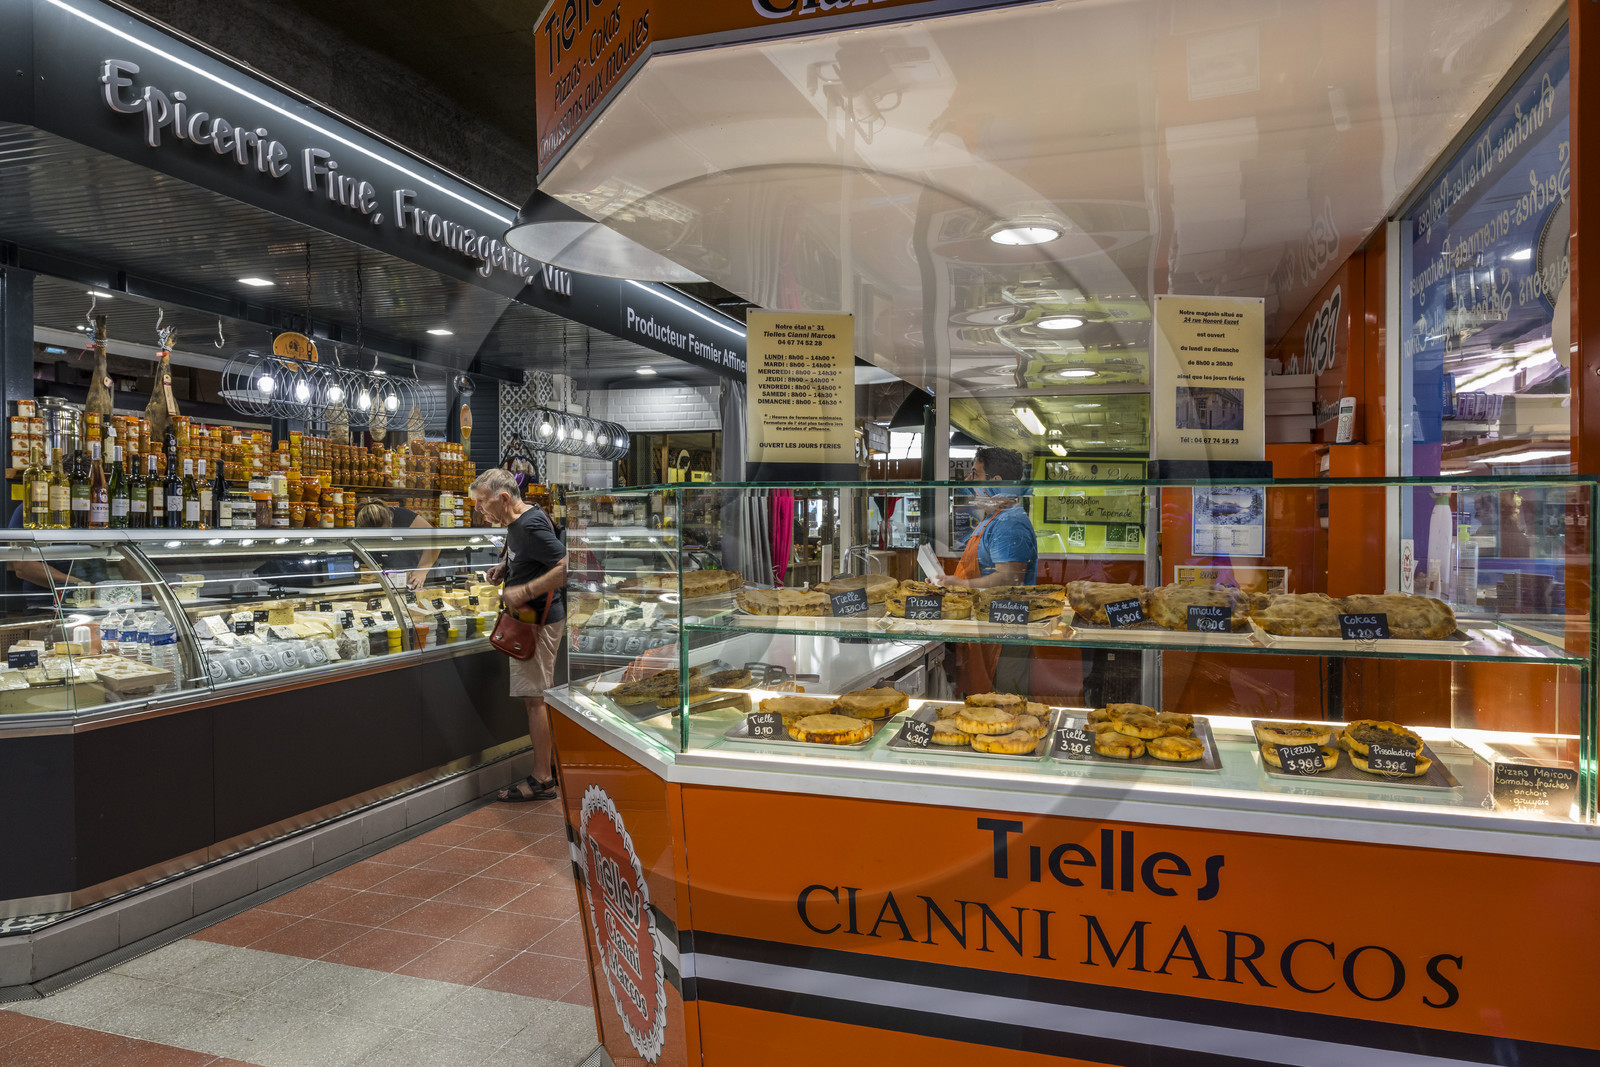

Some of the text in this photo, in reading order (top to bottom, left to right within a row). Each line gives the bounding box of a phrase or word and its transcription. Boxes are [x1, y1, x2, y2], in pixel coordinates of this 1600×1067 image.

[545, 0, 603, 77] Tiel
[555, 2, 621, 113] Pizzas Cokas
[584, 67, 604, 112] aux
[605, 8, 650, 88] moules
[101, 58, 292, 179] Epicerie
[302, 147, 385, 225] Fine,
[541, 261, 573, 297] Vin
[810, 332, 836, 340] Marcos
[1302, 284, 1342, 377] 1937
[626, 306, 747, 374] Producteur Fermier Affine
[1097, 508, 1132, 520] Tapenade
[832, 591, 861, 605] Tielle
[908, 596, 939, 608] Pizzas
[1189, 608, 1223, 616] moule
[749, 714, 775, 724] Tielle
[905, 720, 930, 736] Tielle
[1058, 728, 1089, 742] Tielle
[1280, 746, 1316, 759] Pizzas
[1370, 744, 1416, 760] Pissaladière
[1495, 776, 1534, 787] tomates
[1514, 788, 1548, 798] anchois
[976, 816, 1225, 901] Tielles
[588, 834, 642, 931] Tielles
[604, 908, 643, 981] Cianni
[797, 882, 1464, 1009] CIANNI MARCOS
[606, 938, 649, 1021] Marcos
